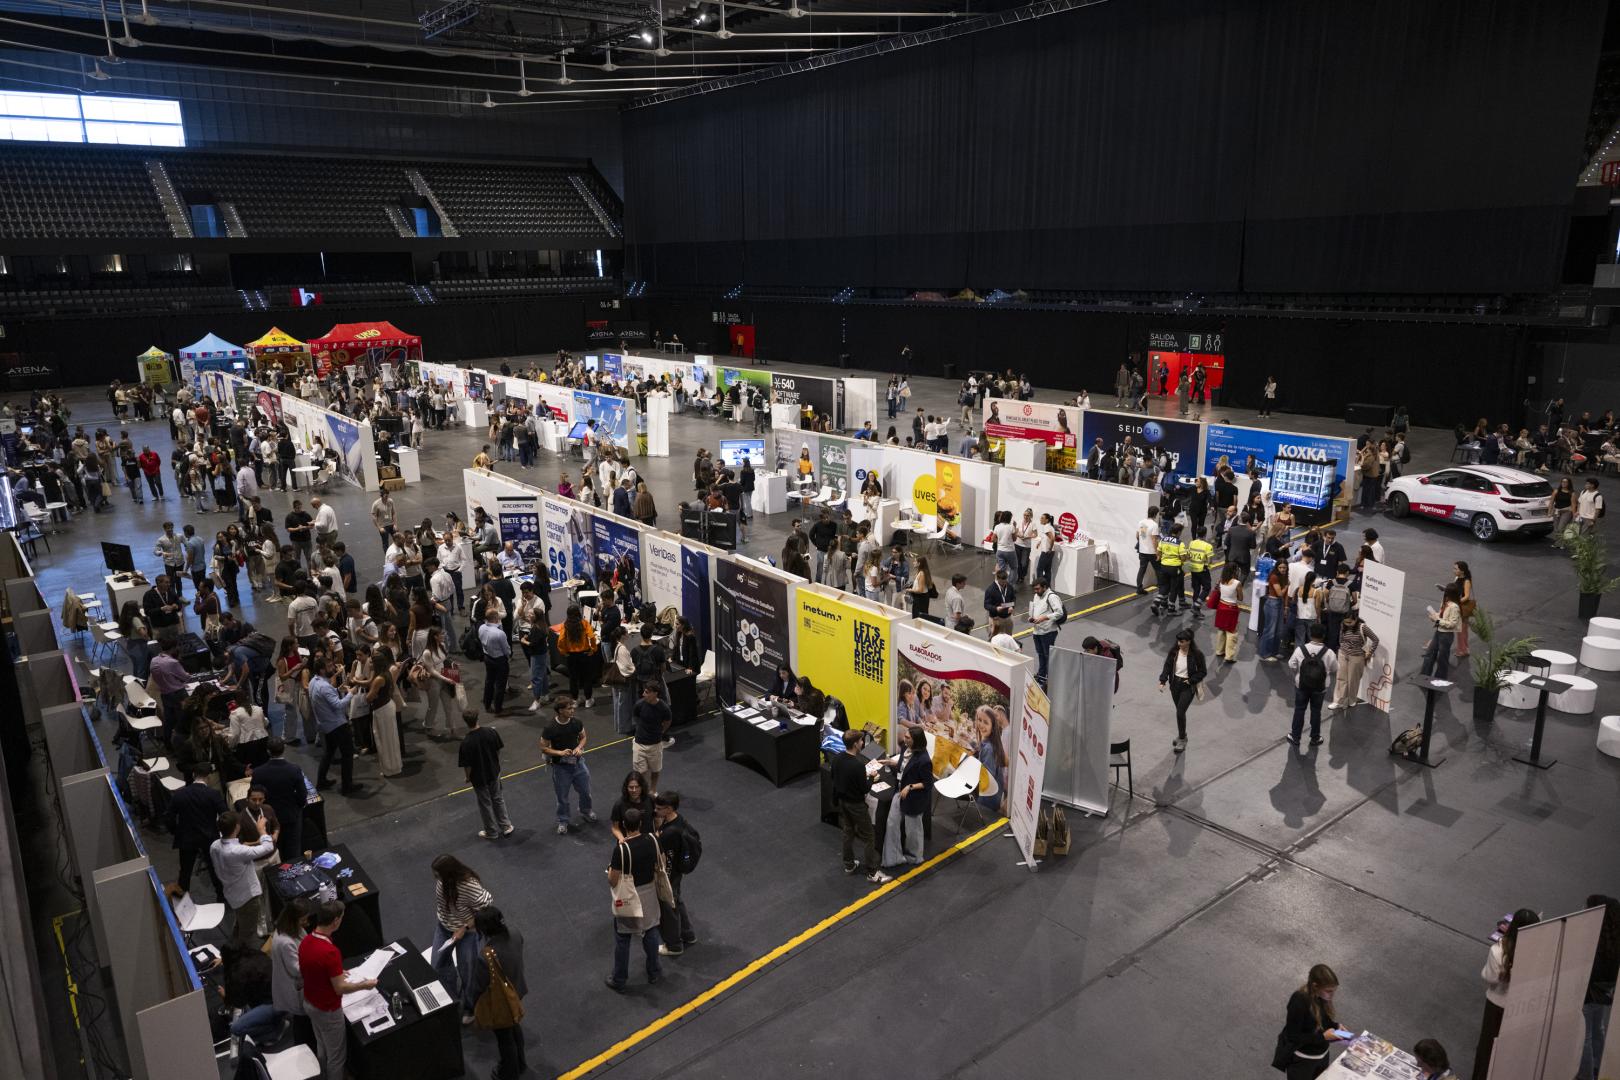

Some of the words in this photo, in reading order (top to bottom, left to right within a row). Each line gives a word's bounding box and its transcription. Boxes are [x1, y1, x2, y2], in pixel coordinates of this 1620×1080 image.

[8, 366, 51, 374] ARENA
[782, 378, 794, 390] 540
[776, 392, 800, 400] OFTWARE
[1118, 424, 1159, 436] SEIDOR
[1278, 444, 1327, 462] KOXKA
[914, 490, 936, 503] uves
[649, 544, 676, 563] VeriDas
[854, 620, 880, 638] LET'S
[854, 628, 885, 650] MAKE
[856, 641, 881, 657] TECH
[910, 644, 942, 661] ELABORADOS
[854, 649, 884, 669] RIGHT
